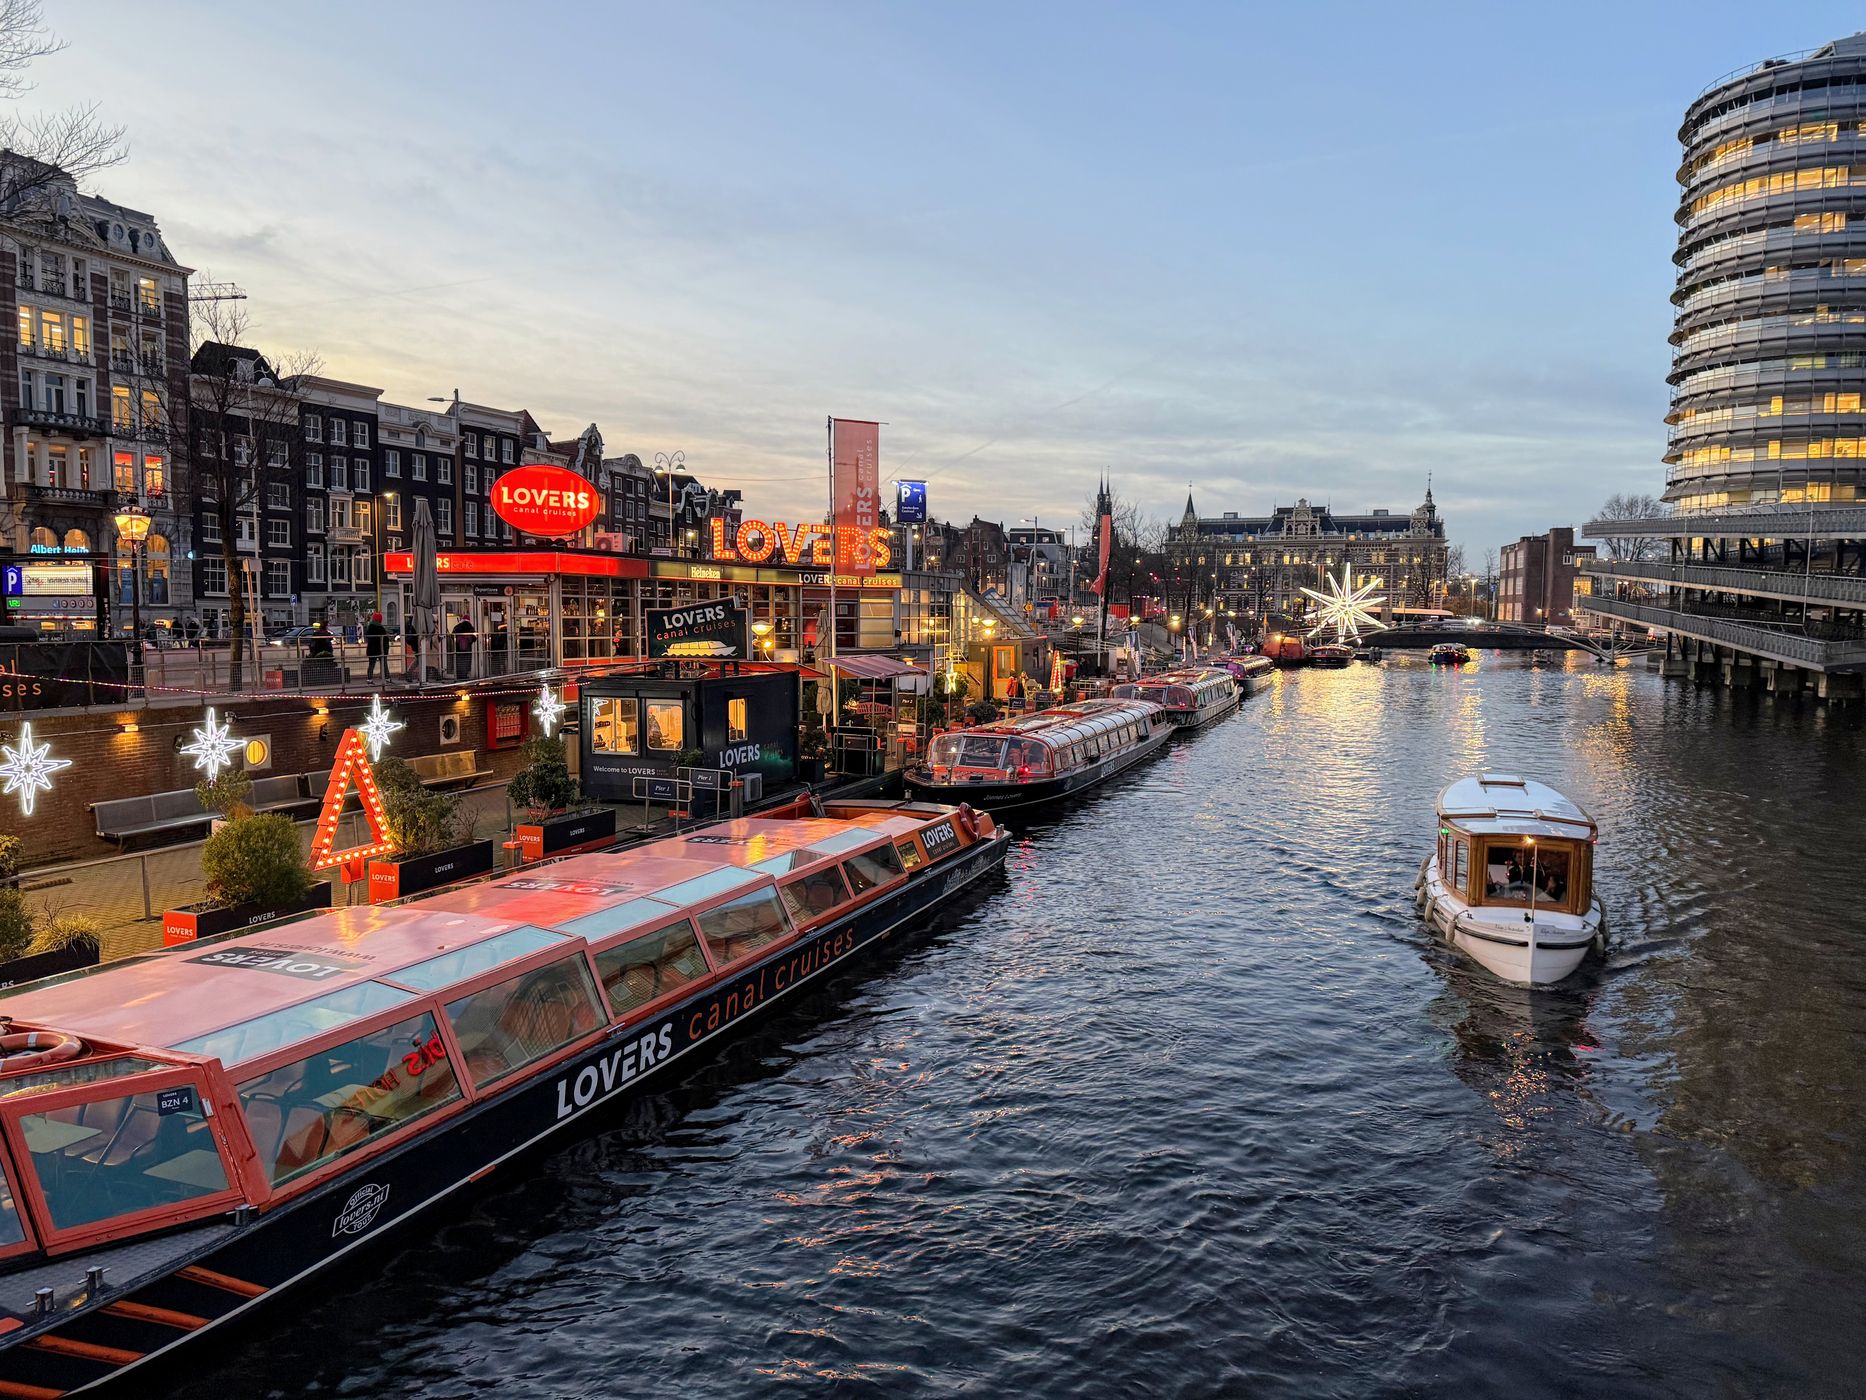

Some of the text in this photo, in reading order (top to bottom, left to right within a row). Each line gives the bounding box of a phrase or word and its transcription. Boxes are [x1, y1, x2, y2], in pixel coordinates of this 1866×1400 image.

[501, 486, 590, 509] LOVERS
[513, 506, 577, 517] canal cruises
[710, 517, 891, 567] LOVERS
[30, 544, 61, 554] Albert
[406, 557, 450, 569] LRS
[691, 566, 721, 579] Heineken
[837, 577, 860, 585] canal
[862, 577, 897, 586] cruises
[662, 605, 726, 630] LOVERS
[656, 620, 737, 641] canal cruises
[719, 743, 760, 768] LOVERS
[593, 765, 620, 773] Welcome
[628, 767, 656, 775] LOVERS
[654, 784, 666, 792] Pier
[519, 834, 541, 842] LOVERS
[569, 827, 586, 837] LOVERS
[921, 822, 955, 849] LOVERS
[434, 862, 454, 874] LOVERS
[371, 873, 396, 882] LOVERS
[248, 911, 276, 924] LOVERS
[166, 926, 194, 937] LOVERS
[201, 953, 341, 977] LOVERS
[556, 927, 855, 1119] LOVERS canal cruises
[161, 1096, 189, 1109] BZN 4
[339, 1189, 385, 1229] lovers.nl
